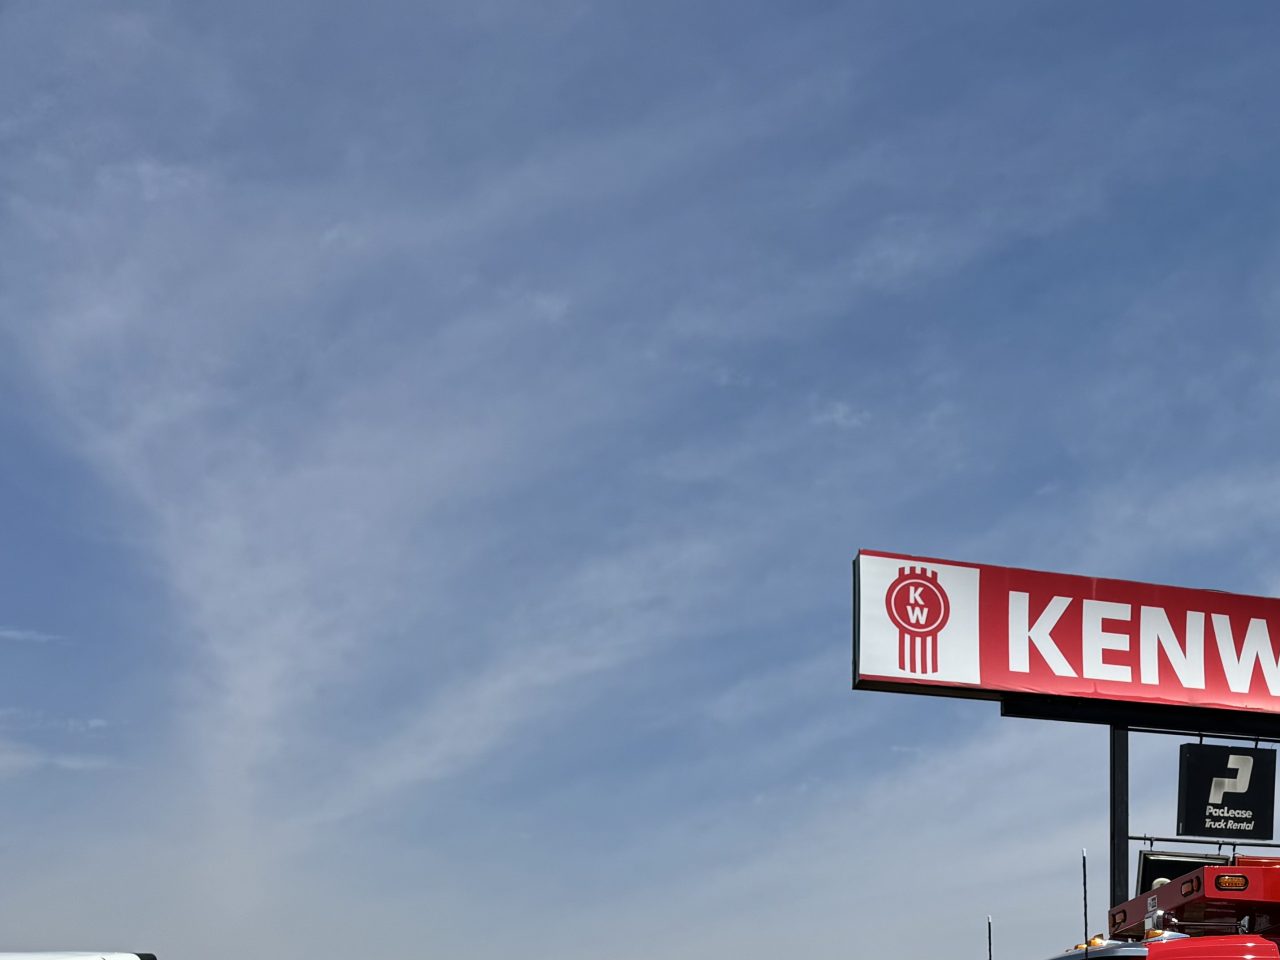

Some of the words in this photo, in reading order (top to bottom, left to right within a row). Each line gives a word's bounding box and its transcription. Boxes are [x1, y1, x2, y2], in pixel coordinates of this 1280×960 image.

[1206, 806, 1253, 818] PacLease
[1205, 819, 1226, 829] Truck
[1227, 820, 1255, 830] Rental
